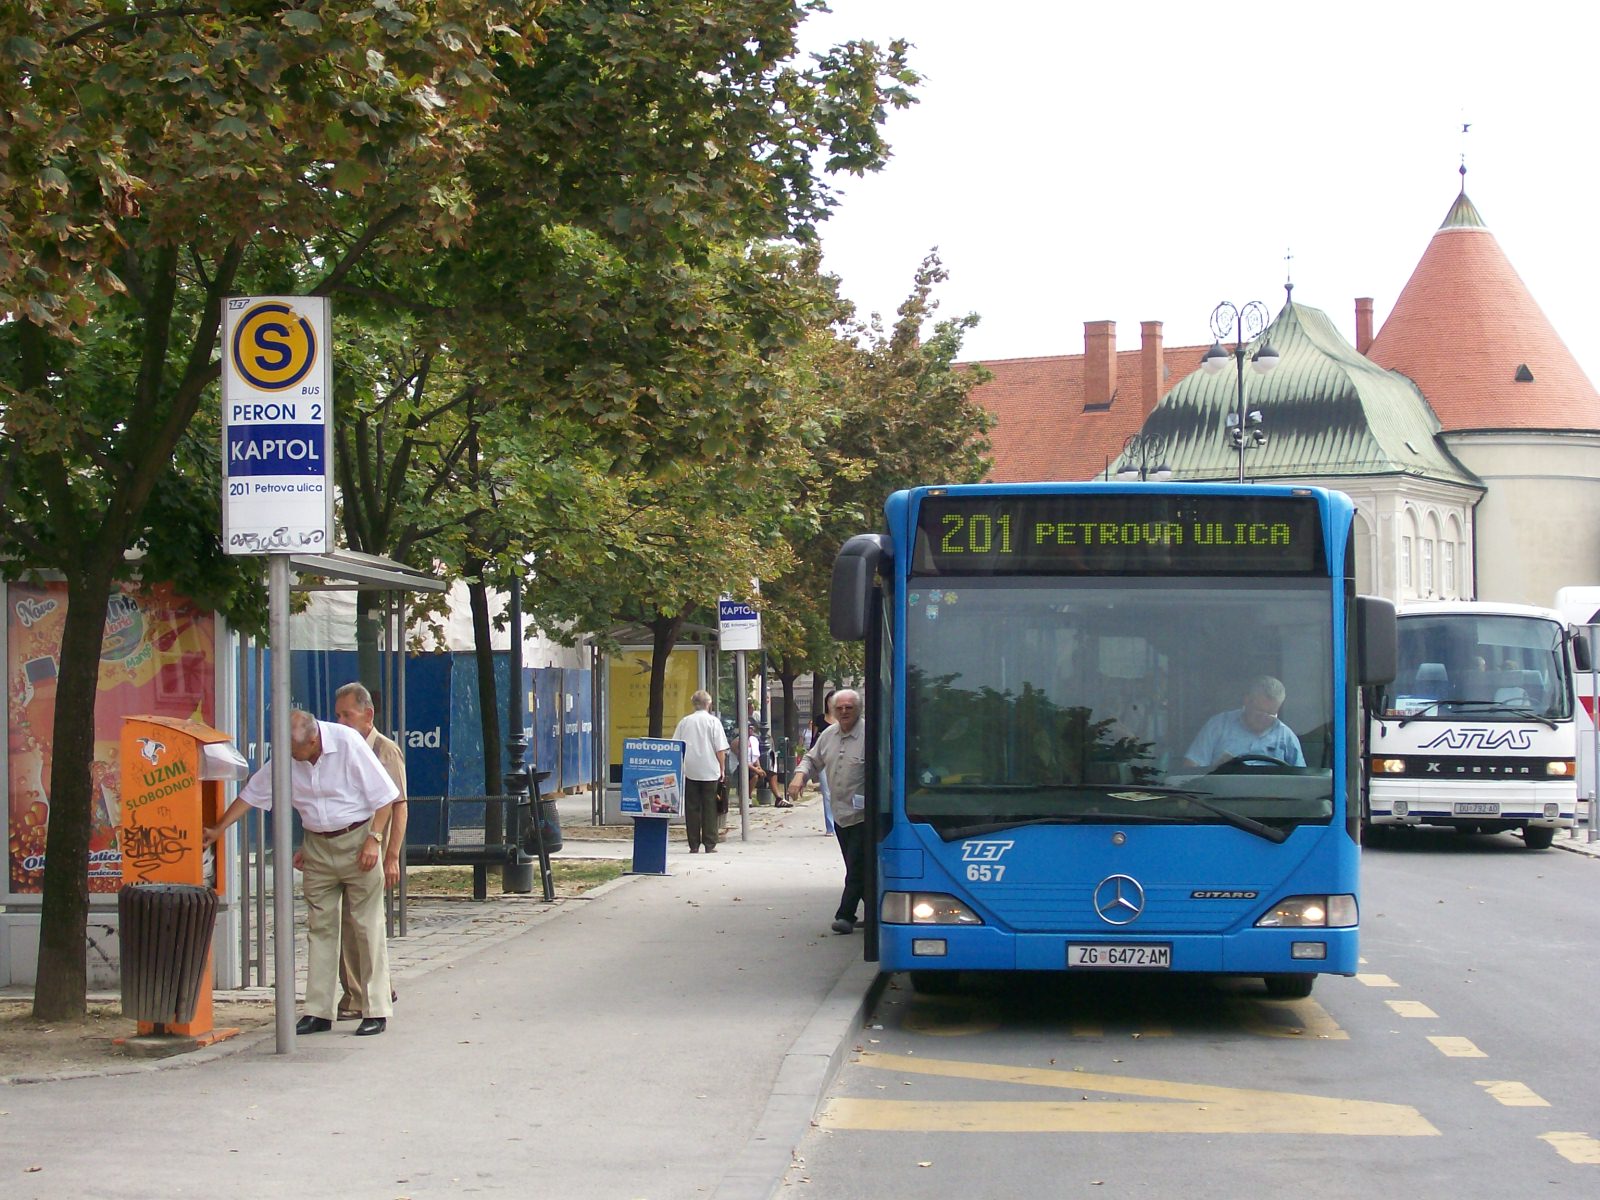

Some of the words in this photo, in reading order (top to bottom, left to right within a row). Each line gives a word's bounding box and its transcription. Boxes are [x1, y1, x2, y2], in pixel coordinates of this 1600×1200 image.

[254, 323, 292, 371] S
[301, 386, 320, 395] BUS
[233, 404, 296, 421] PERON
[311, 404, 322, 420] 2
[231, 439, 319, 461] KAPTOL
[229, 482, 250, 496] 201
[255, 483, 294, 493] Petrova
[296, 482, 323, 492] ulica
[941, 514, 1013, 553] 201
[1035, 523, 1183, 545] PETROVA
[1194, 523, 1291, 545] ULICA
[625, 741, 681, 753] metropola
[1417, 728, 1539, 750] ATLAS
[629, 757, 673, 766] BESPLATNO
[1456, 766, 1530, 774] SETRA
[143, 760, 187, 787] UZMI
[125, 776, 196, 811] SLOBODNO!
[961, 840, 1016, 861] ZET
[966, 865, 1006, 882] 657
[1193, 891, 1257, 899] CITARO
[1079, 947, 1098, 964] ZG
[1108, 947, 1169, 965] 6472-AM
